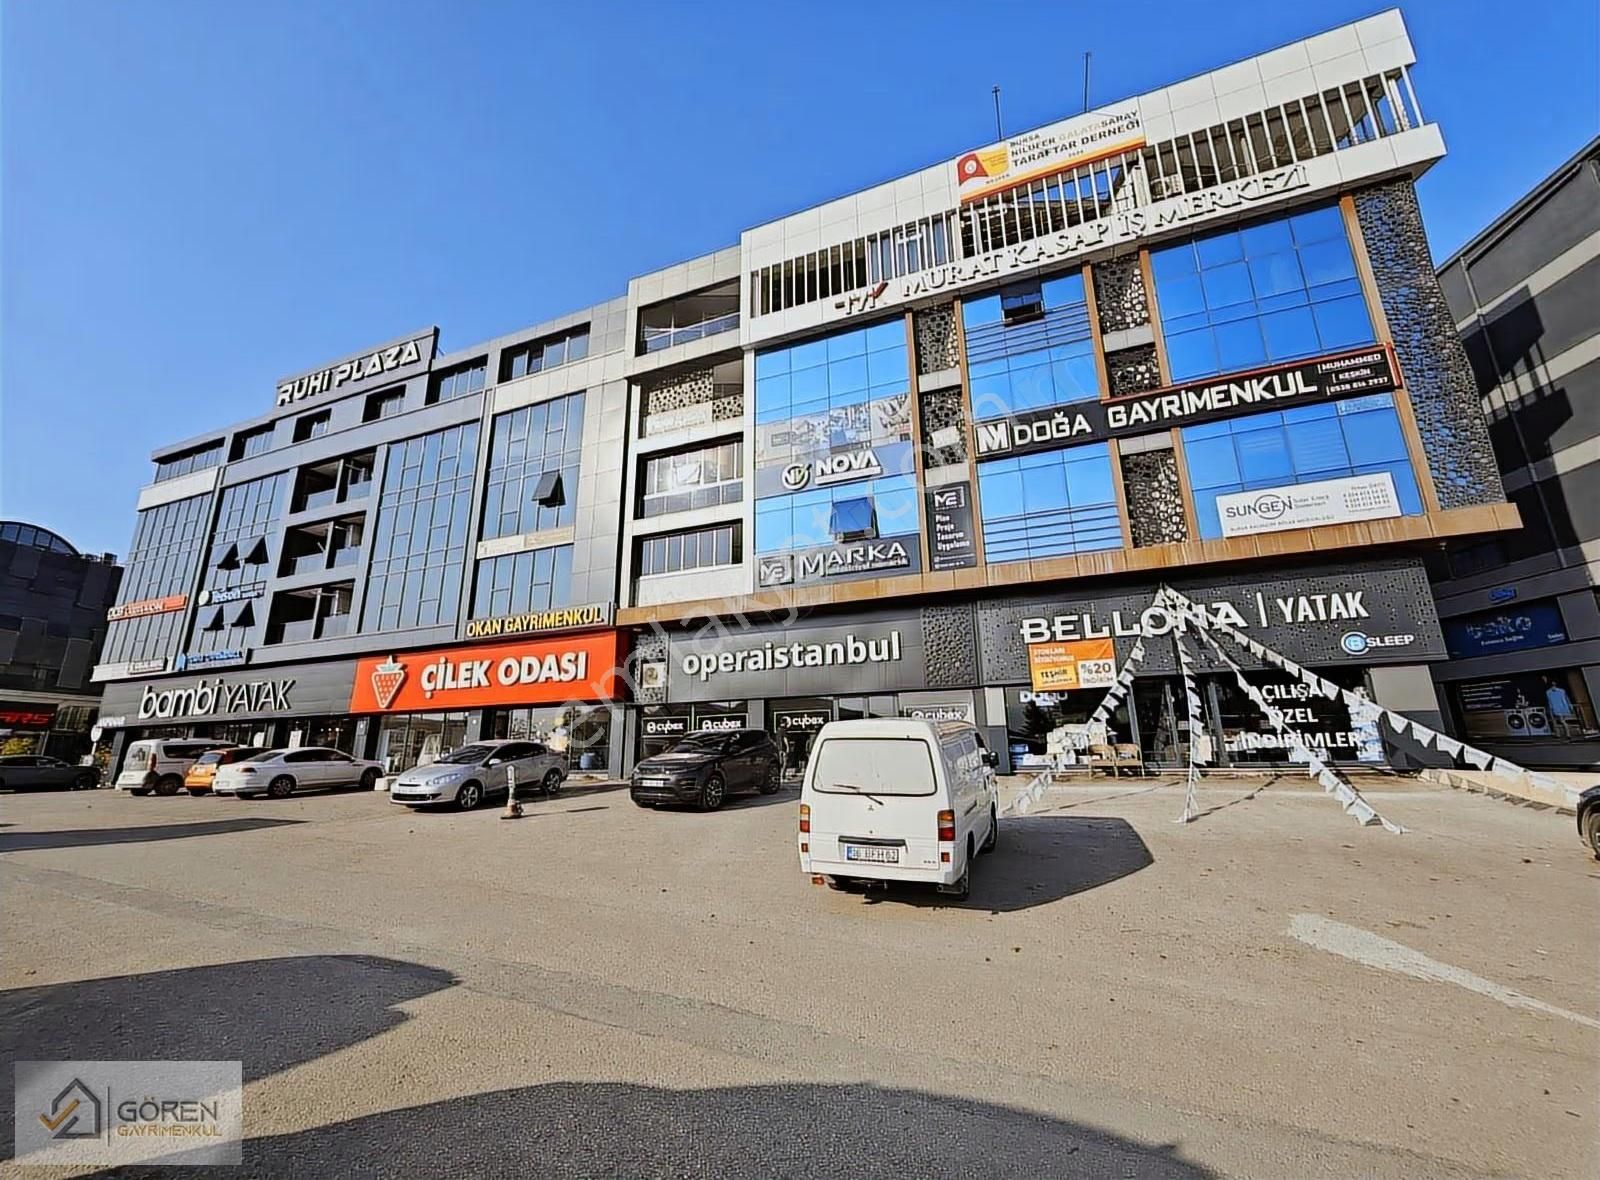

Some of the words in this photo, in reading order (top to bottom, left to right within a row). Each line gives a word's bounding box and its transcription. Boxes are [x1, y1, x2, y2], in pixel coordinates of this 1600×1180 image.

[1009, 132, 1040, 147] BURSA
[1013, 140, 1078, 167] TARAFTAR
[1081, 118, 1140, 145] DERNEĞİ
[1058, 109, 1138, 145] GALATASARAY
[902, 250, 1004, 297] MURAT
[1007, 222, 1110, 270] KASAP
[1118, 210, 1149, 240] İŞ
[1153, 163, 1311, 229] MERKEZİ
[335, 340, 420, 388] PLAZA
[1322, 353, 1381, 371] MUHAMMED
[1013, 410, 1093, 446] DOĞA
[1107, 370, 1318, 429] GAYRİMENKUL
[815, 449, 879, 474] NOVA
[1226, 496, 1293, 518] SUNGEN
[800, 541, 908, 579] MARKA
[466, 619, 502, 638] OKAN
[504, 606, 603, 633] GAYRİMENKUL
[1020, 599, 1250, 645] BELLONA
[1276, 590, 1370, 624] YATAK
[682, 631, 902, 681] operaistanbul
[1366, 634, 1415, 647] SLEEP
[421, 655, 493, 700] ÇİLEK
[497, 651, 588, 686] ODASI
[138, 679, 224, 719] bambi
[225, 679, 297, 712] YATAK
[656, 720, 684, 734] cybex
[792, 714, 824, 729] cybex
